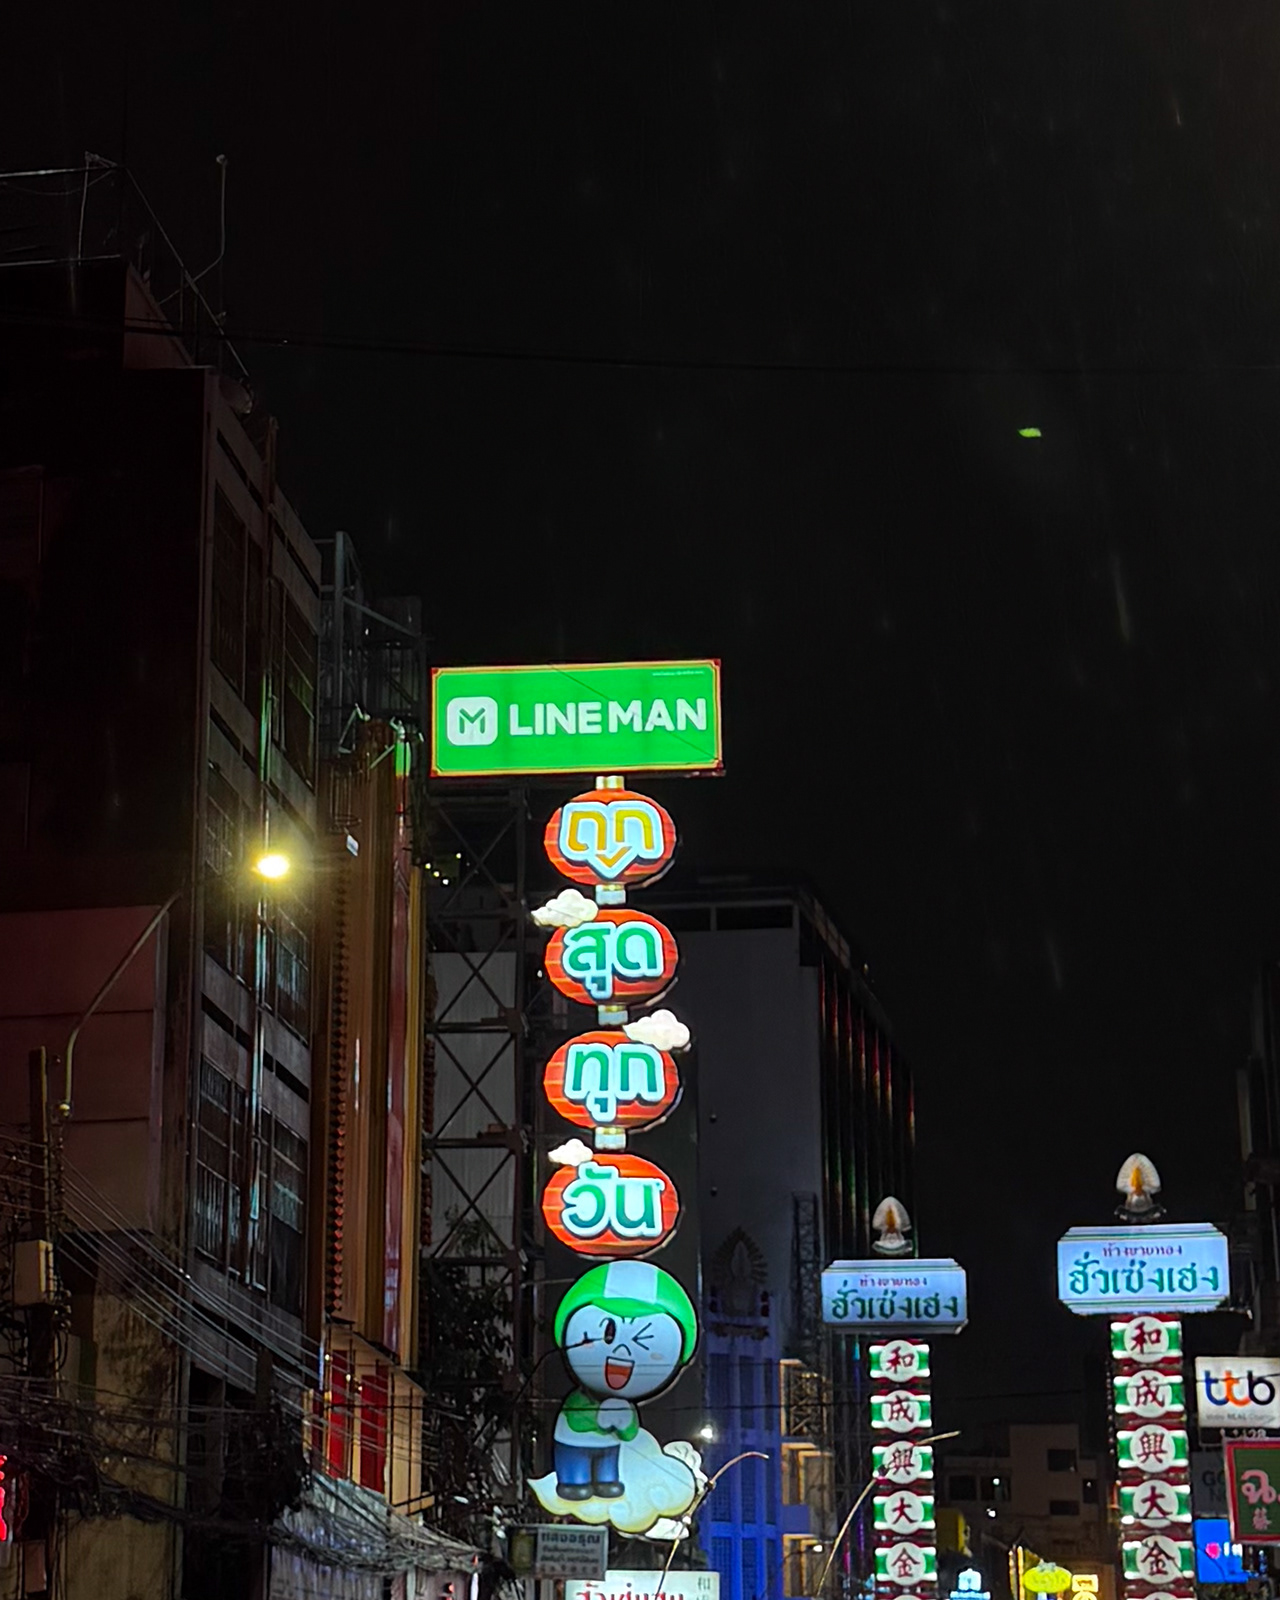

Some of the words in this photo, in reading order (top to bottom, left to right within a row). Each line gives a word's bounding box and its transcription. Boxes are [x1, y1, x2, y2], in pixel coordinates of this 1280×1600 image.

[508, 700, 603, 737] LINE
[608, 697, 708, 733] MAN
[565, 922, 662, 997] สุด
[568, 1044, 662, 1120] ทุก
[563, 1162, 665, 1236] วัน
[1203, 1369, 1276, 1407] ttb
